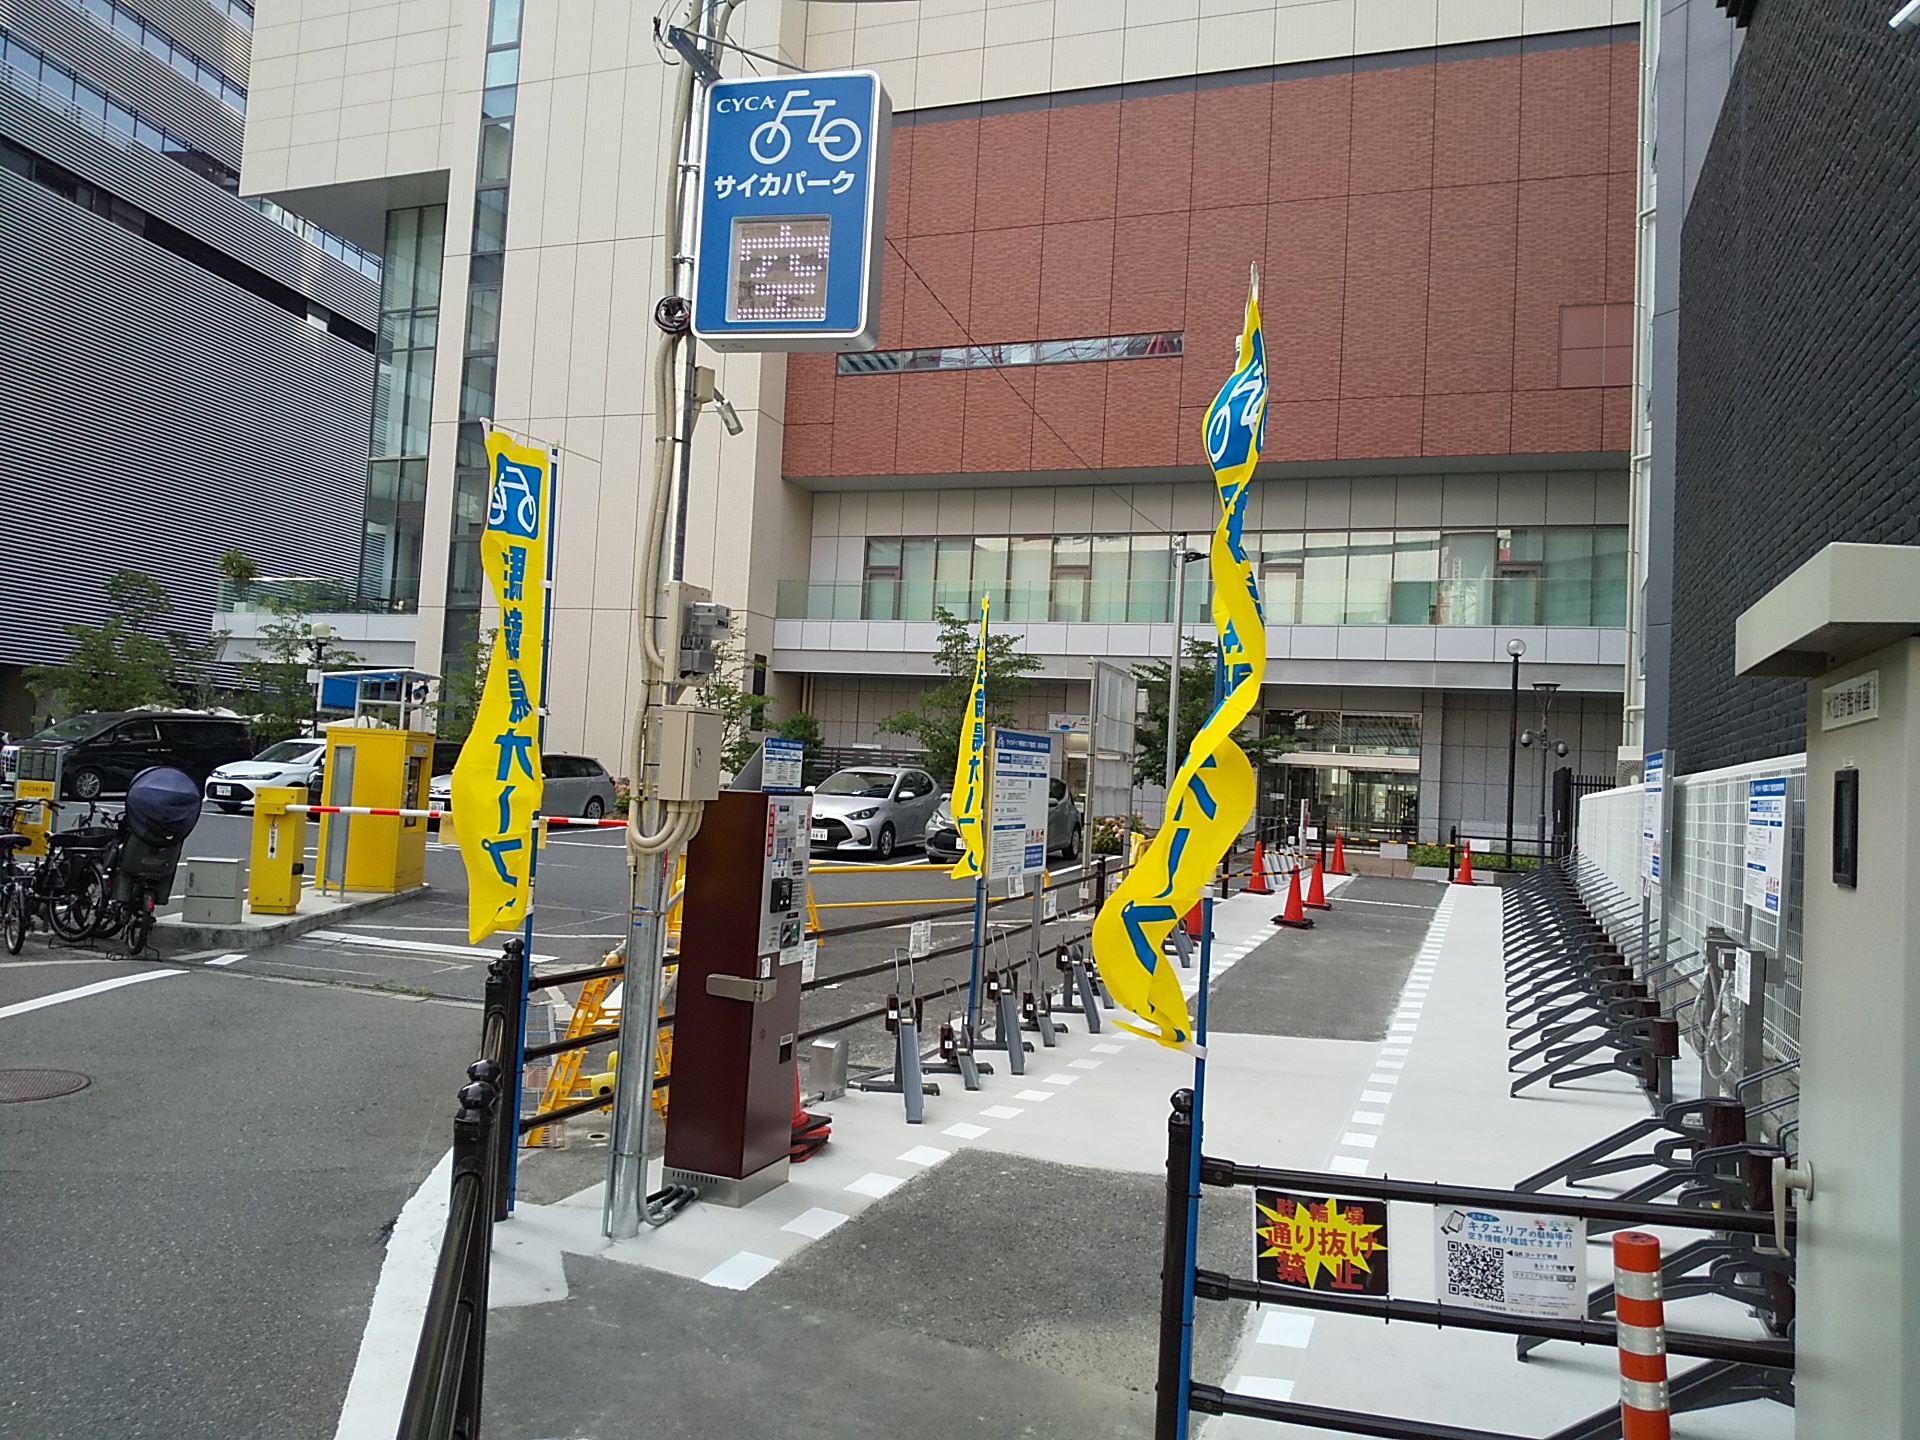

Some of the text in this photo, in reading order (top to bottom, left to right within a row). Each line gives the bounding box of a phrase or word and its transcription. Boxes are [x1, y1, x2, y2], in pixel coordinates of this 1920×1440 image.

[716, 95, 777, 114] CYCA
[714, 170, 856, 200] サイカパーク
[1276, 1198, 1364, 1226] 駐輪場
[1265, 1218, 1378, 1259] 通り抜け
[1468, 1221, 1572, 1240] キタエリアの駐輪場の
[1276, 1250, 1364, 1290] 禁止
